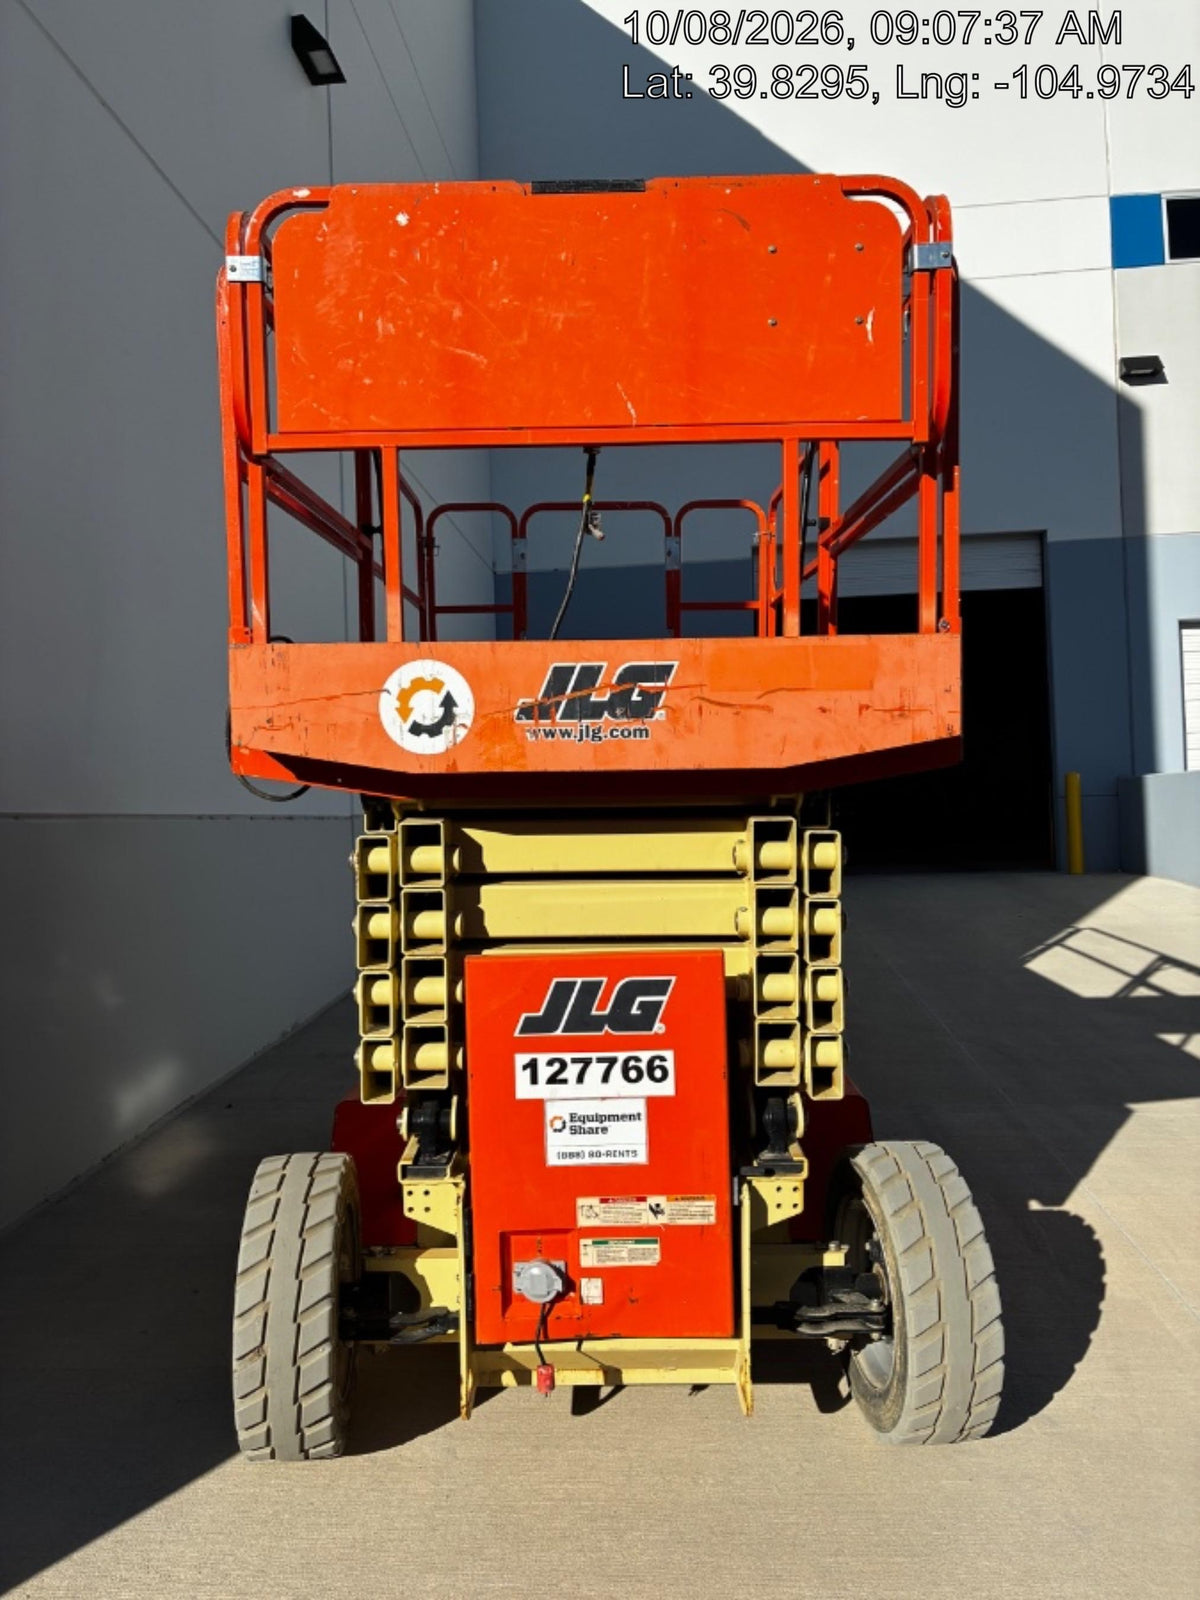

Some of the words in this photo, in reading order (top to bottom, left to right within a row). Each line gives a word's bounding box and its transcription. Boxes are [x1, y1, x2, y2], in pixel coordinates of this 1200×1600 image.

[514, 660, 680, 722] JLG
[526, 724, 650, 742] www.jlg.com
[514, 976, 677, 1036] JLG
[522, 1054, 669, 1085] 127766
[569, 1112, 641, 1124] Equipment
[569, 1125, 608, 1135] Share
